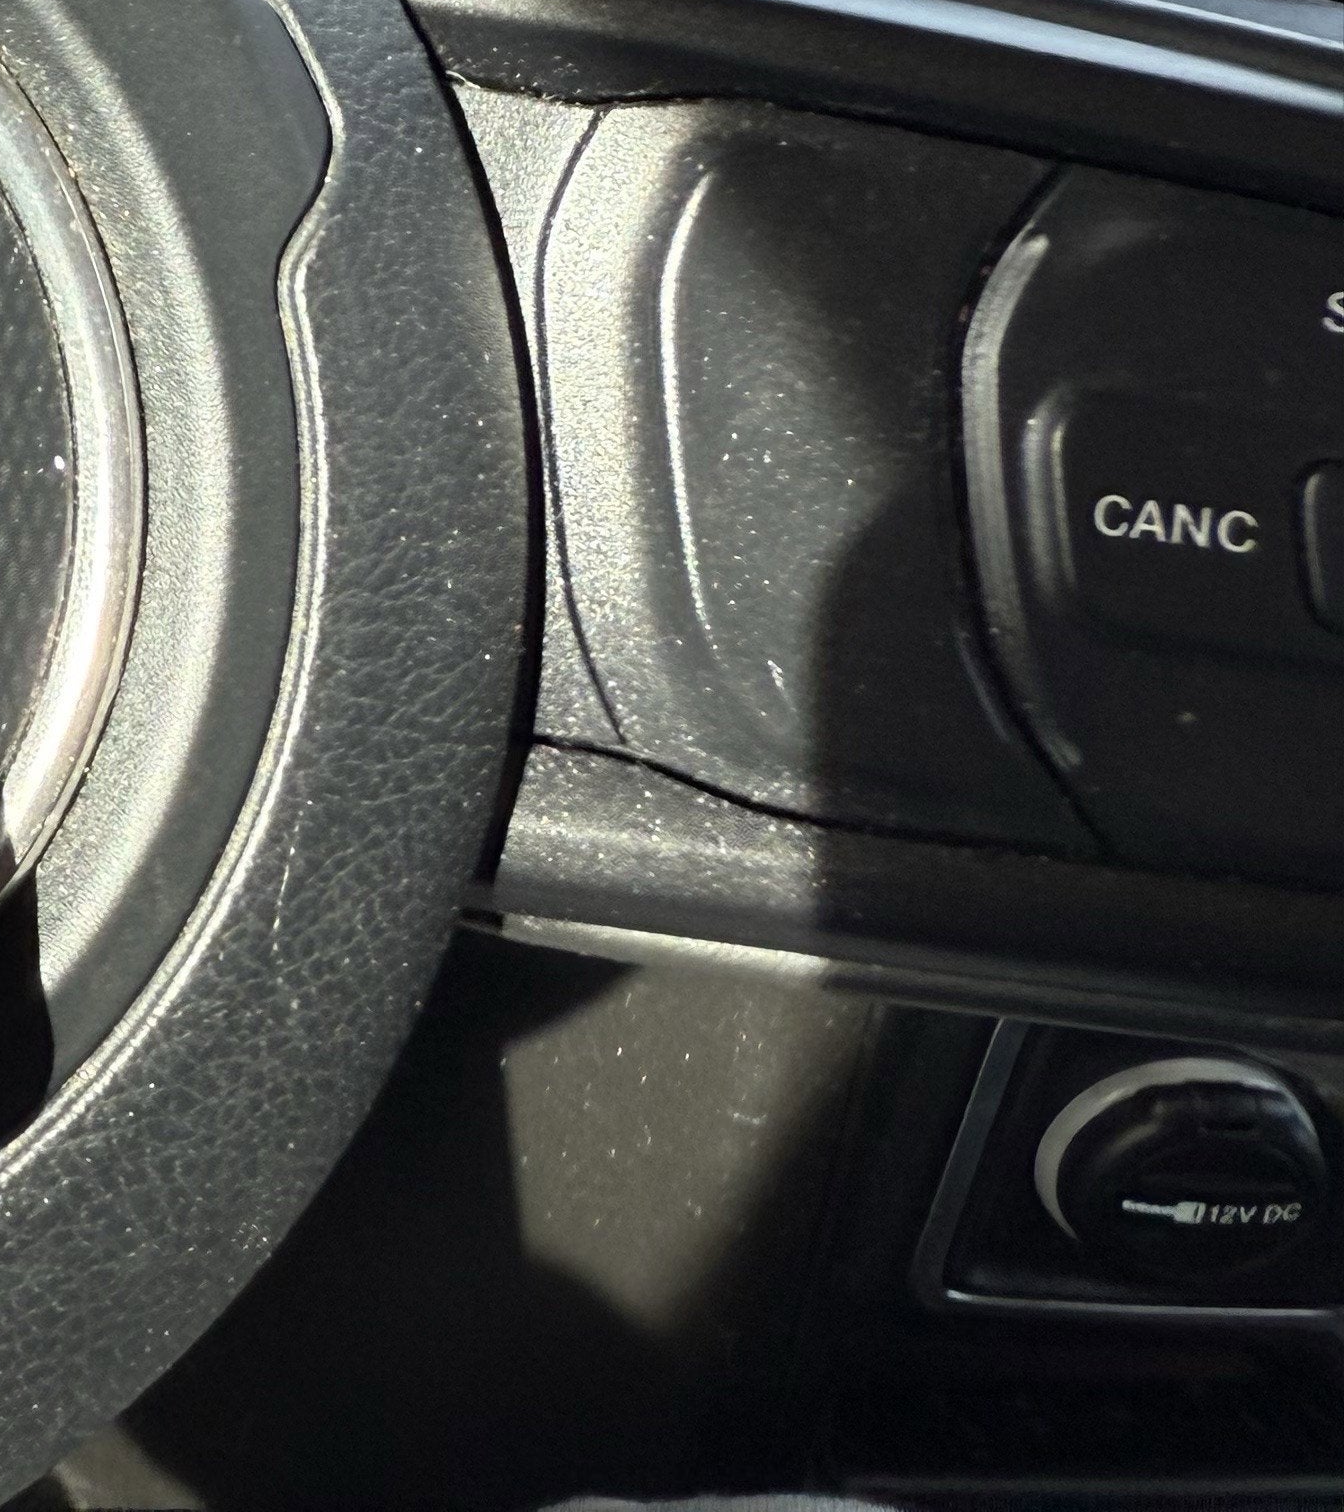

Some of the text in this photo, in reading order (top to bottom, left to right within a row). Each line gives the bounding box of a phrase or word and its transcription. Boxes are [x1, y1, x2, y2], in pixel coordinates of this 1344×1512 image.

[1094, 494, 1259, 553] CANC
[1211, 1202, 1302, 1224] 12V DC
